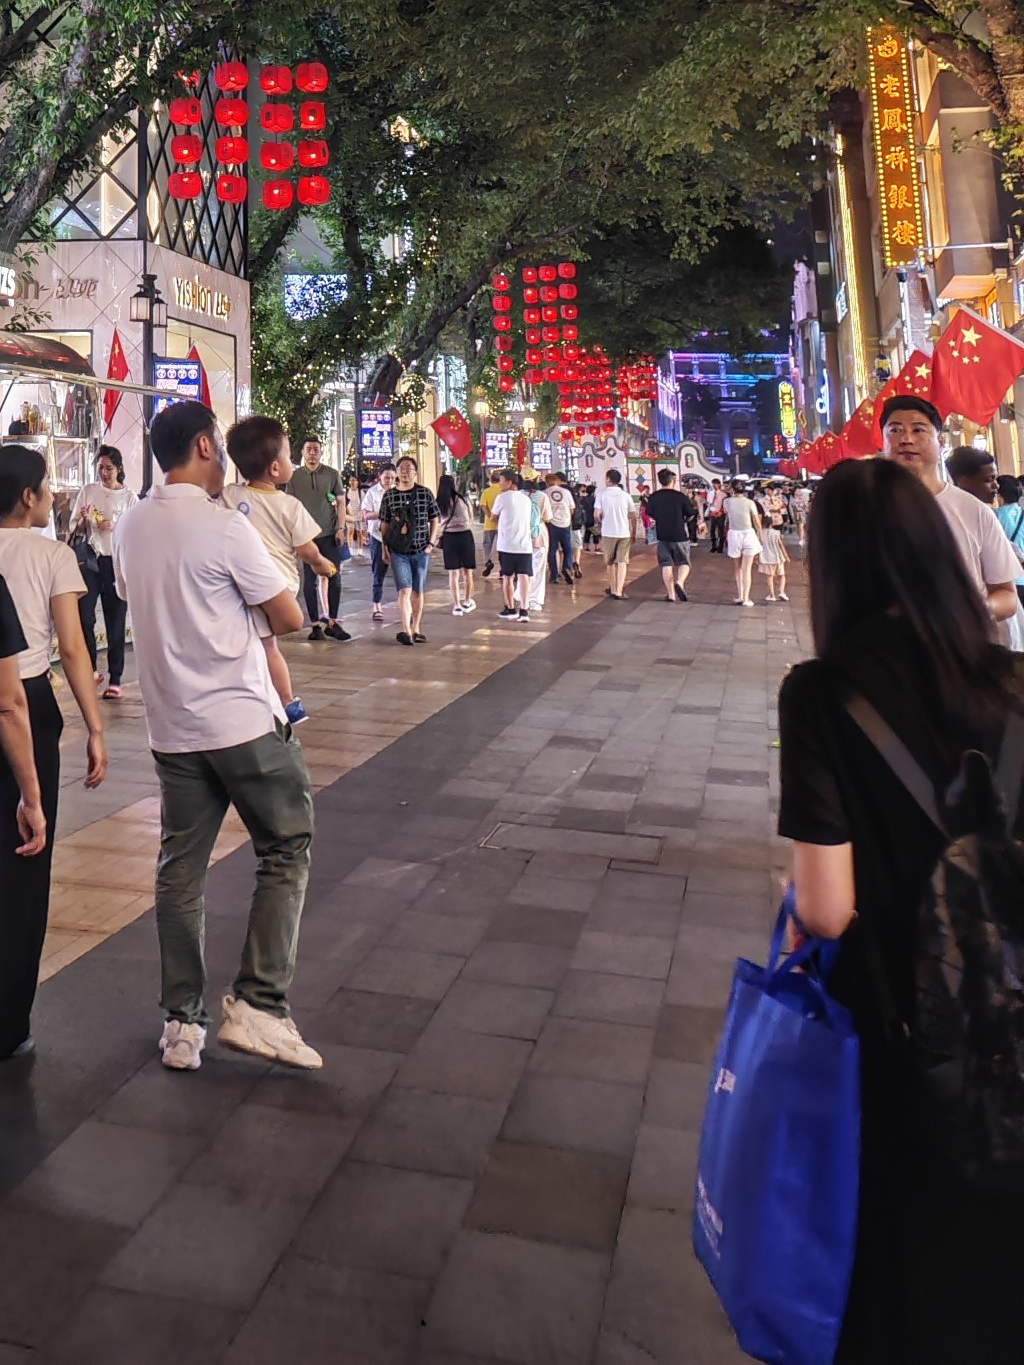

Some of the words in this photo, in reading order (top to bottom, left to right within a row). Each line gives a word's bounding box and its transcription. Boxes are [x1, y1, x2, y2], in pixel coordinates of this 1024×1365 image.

[879, 73, 917, 246] 老鳳祥銀樓
